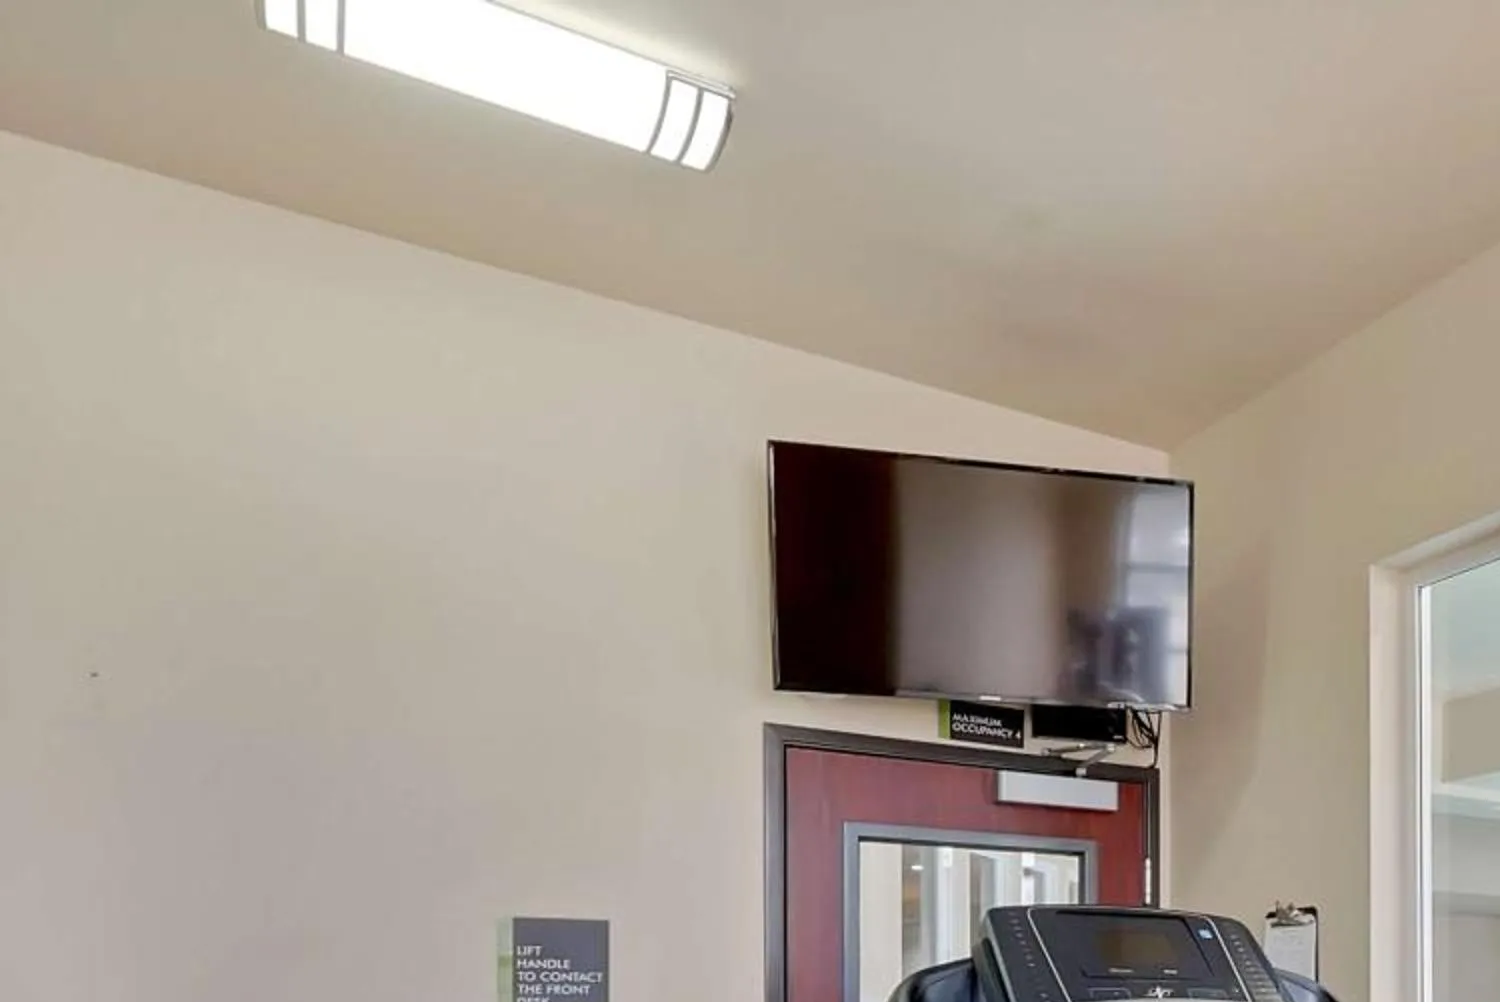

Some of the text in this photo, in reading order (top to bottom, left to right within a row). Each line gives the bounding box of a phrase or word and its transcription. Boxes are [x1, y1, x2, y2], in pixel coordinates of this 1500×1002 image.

[953, 713, 1002, 726] MAXIMUM
[952, 722, 1013, 738] OCCUPANCY
[517, 945, 542, 956] LIFT
[517, 959, 571, 969] HANDLE
[517, 971, 603, 983] TO CONTACT
[517, 984, 591, 995] THE FRONT
